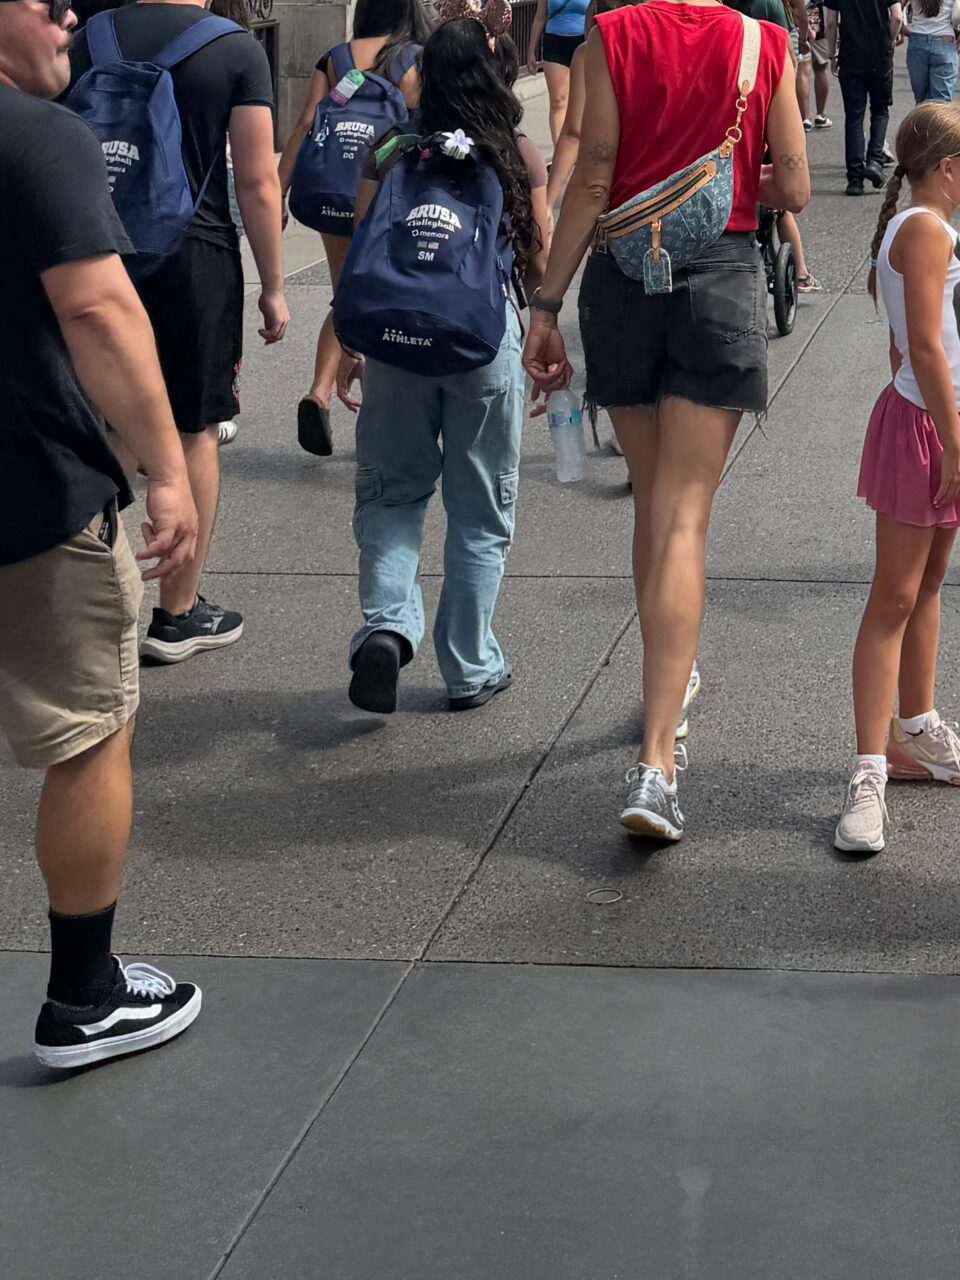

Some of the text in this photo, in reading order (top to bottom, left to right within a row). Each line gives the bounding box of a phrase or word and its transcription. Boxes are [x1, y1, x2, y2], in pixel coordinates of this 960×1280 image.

[101, 140, 140, 161] RUSA
[405, 204, 462, 229] BRUSA
[417, 251, 435, 262] SM
[382, 332, 433, 347] ATHLETA
